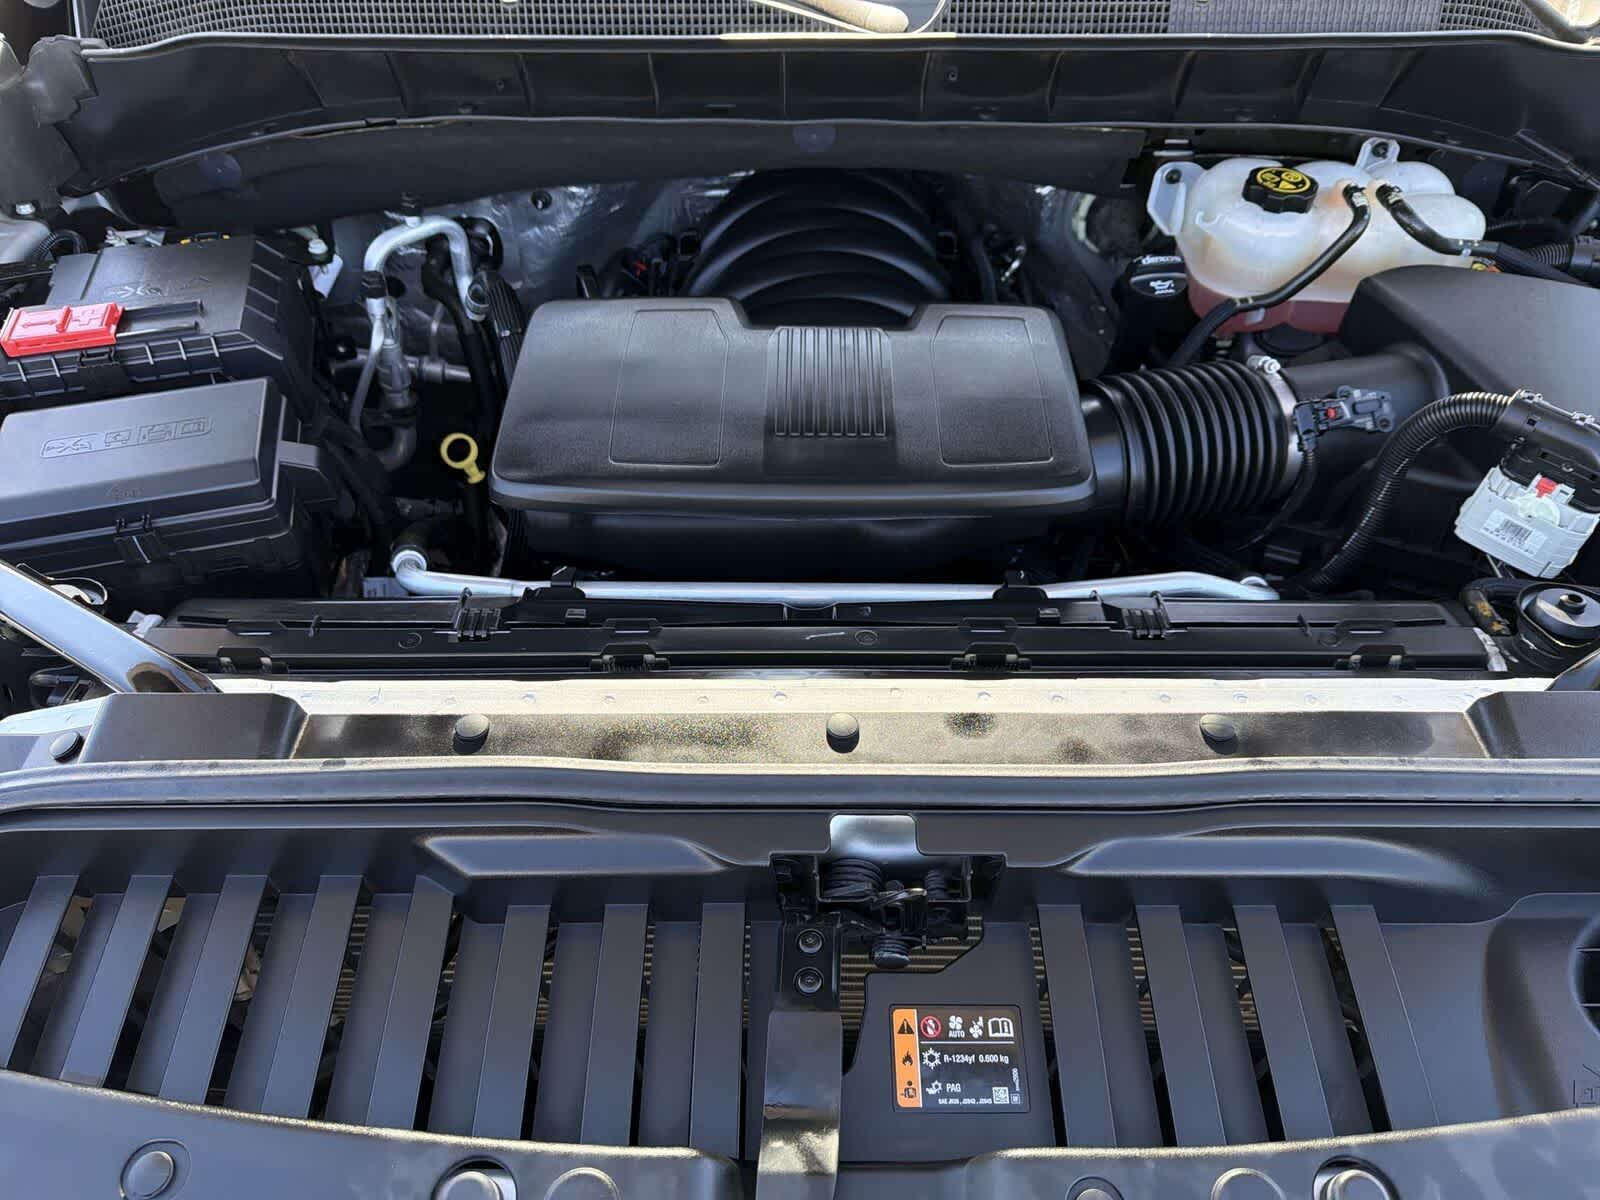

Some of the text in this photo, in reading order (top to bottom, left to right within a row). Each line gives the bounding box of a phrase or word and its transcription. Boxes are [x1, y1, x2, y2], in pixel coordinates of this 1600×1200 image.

[948, 1030, 965, 1038] AUTO
[943, 1054, 1009, 1064] R-1234yf 0.600 kg
[946, 1083, 961, 1092] PAG
